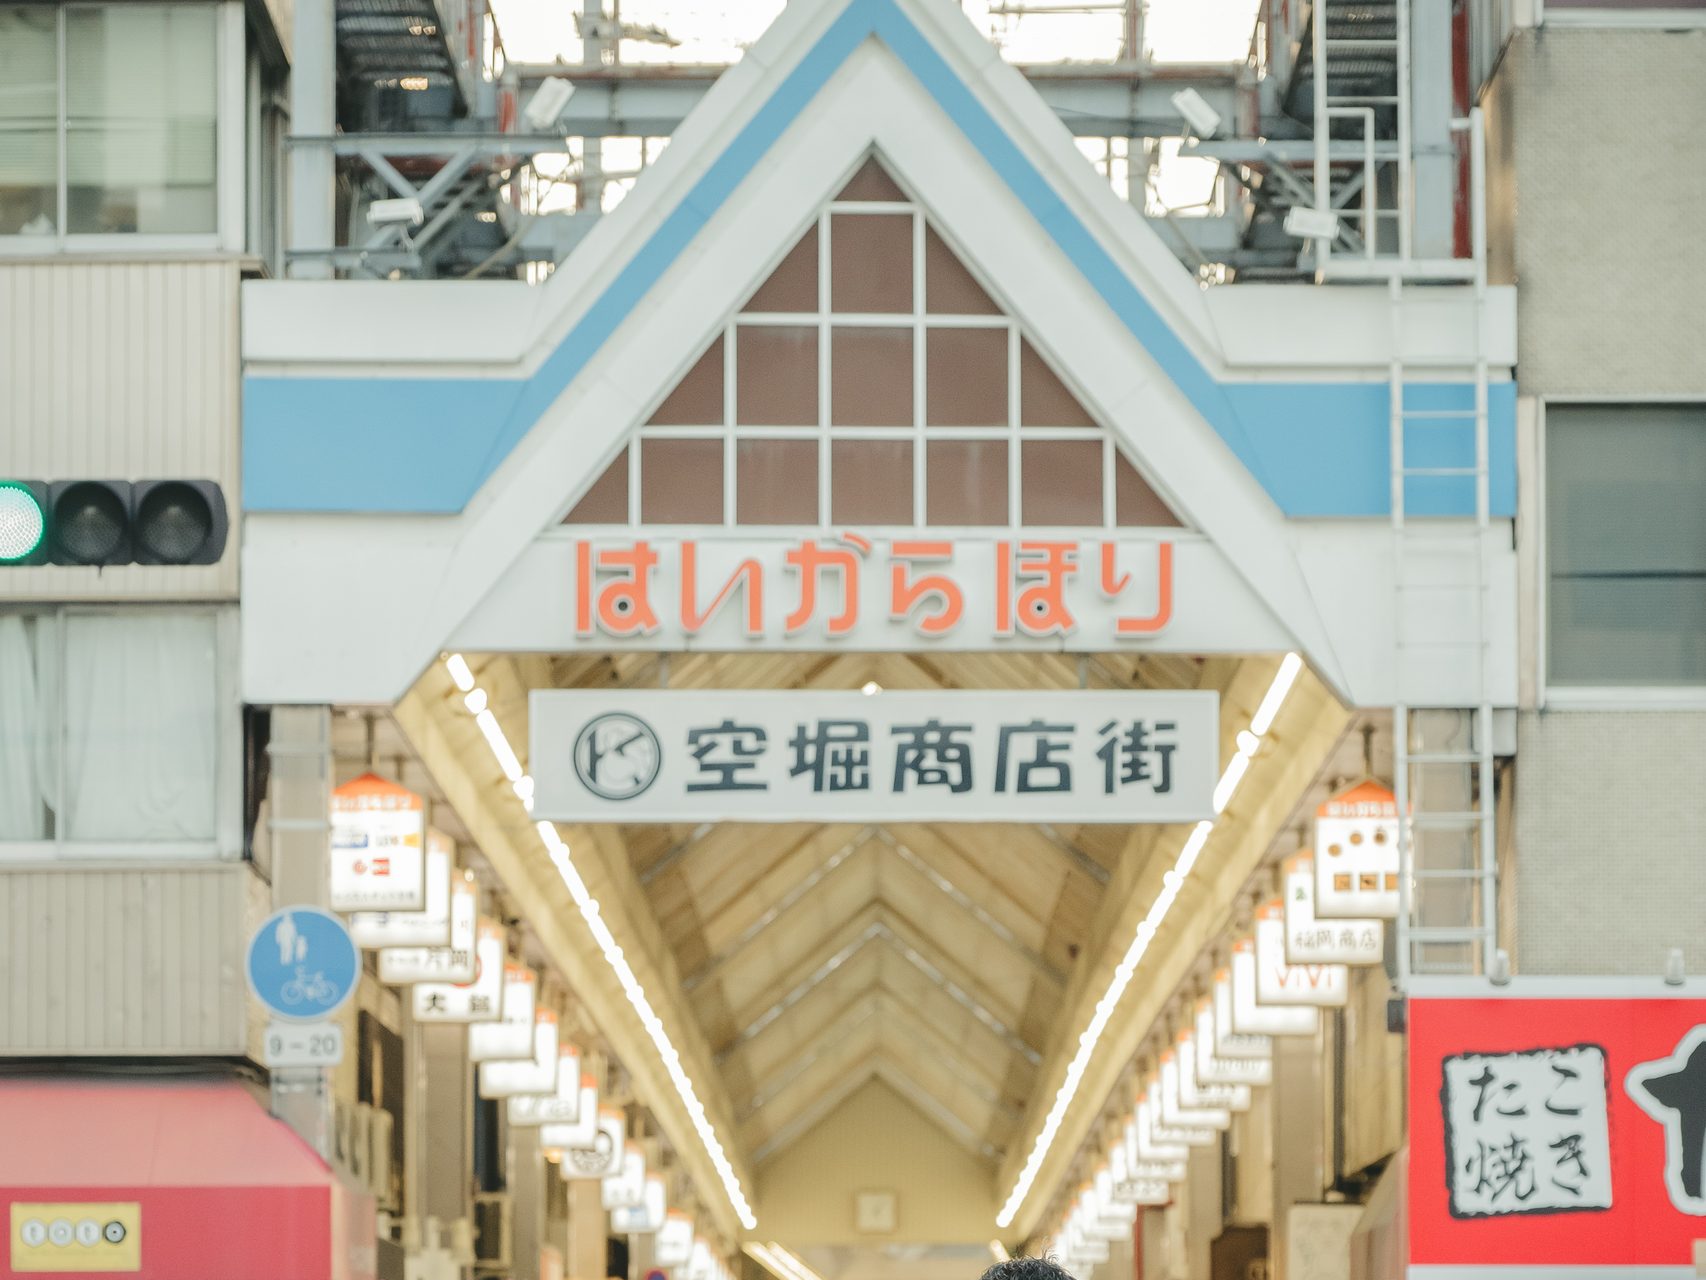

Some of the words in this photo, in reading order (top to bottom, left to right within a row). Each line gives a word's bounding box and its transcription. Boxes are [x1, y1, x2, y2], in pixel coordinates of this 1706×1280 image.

[575, 533, 1173, 634] はいからほり
[686, 719, 1178, 794] 空堀商店街
[1468, 1065, 1582, 1123] たこ
[1465, 1131, 1590, 1202] 焼き
